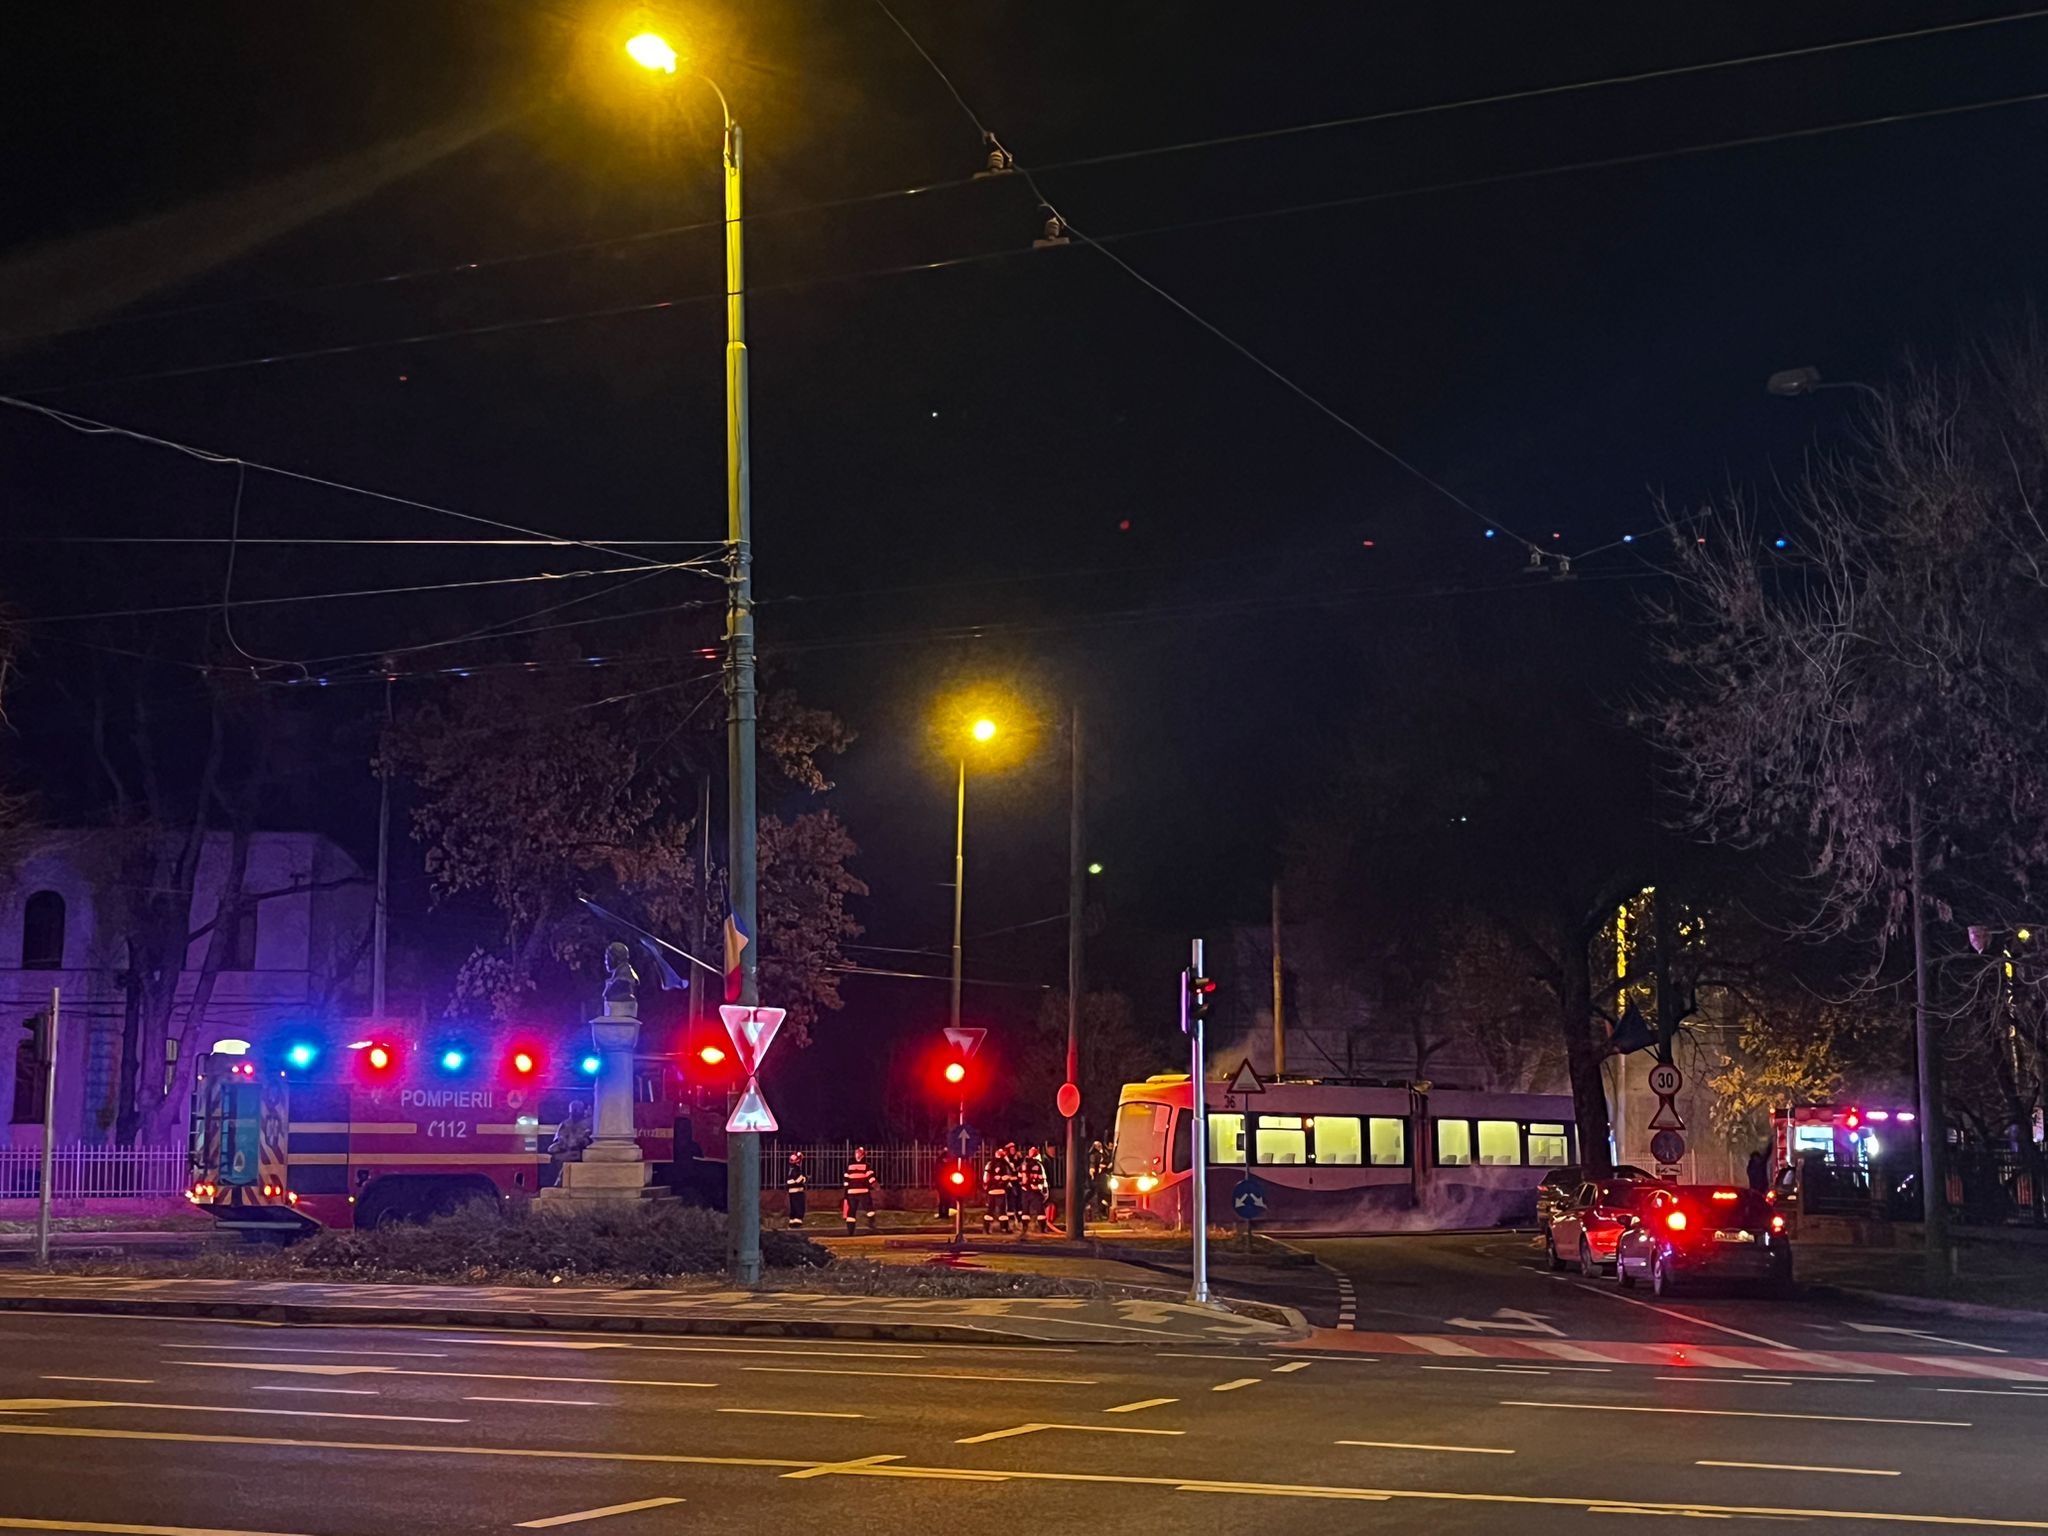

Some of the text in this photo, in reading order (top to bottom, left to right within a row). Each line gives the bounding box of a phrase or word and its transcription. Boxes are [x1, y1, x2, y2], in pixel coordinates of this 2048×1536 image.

[1658, 1072, 1674, 1089] 30
[400, 1089, 493, 1108] POMPIERII
[437, 1120, 467, 1138] 112
